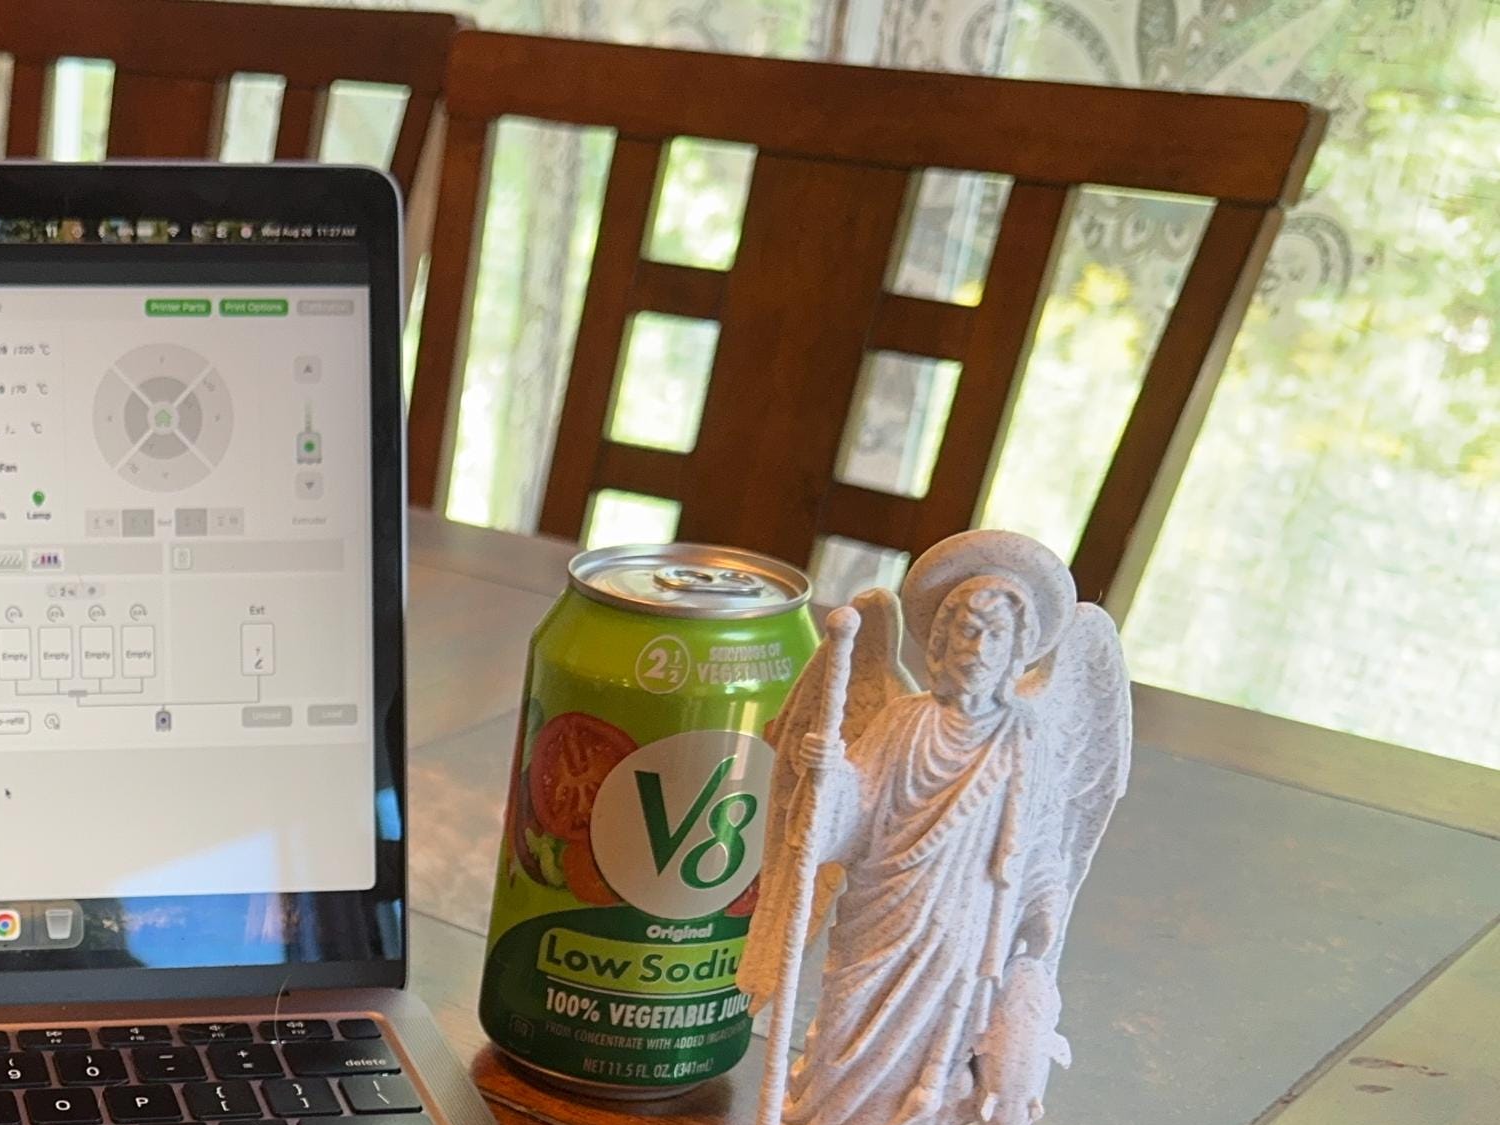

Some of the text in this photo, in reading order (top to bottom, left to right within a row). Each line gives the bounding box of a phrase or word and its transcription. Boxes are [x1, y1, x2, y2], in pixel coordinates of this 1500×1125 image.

[151, 302, 180, 312] Printer
[225, 302, 282, 314] Print Options
[26, 511, 52, 521] Lamp
[250, 605, 265, 616] Ext
[2, 652, 28, 661] Empty
[43, 651, 69, 660] Empty
[84, 650, 110, 660] Empty
[126, 650, 152, 659] Empty
[634, 755, 758, 890] V8
[646, 923, 713, 942] Original
[548, 934, 741, 984] Low Sodiu
[546, 987, 750, 1029] 100% VEGETABLE JUIC
[575, 1029, 643, 1050] CONCENTRATE
[647, 1038, 671, 1050] WITH
[674, 1035, 705, 1049] ADDED
[345, 1058, 387, 1068] delete
[7, 1069, 21, 1080] 9
[86, 1066, 100, 1077] 0
[55, 1100, 71, 1111] O
[135, 1097, 149, 1108] P
